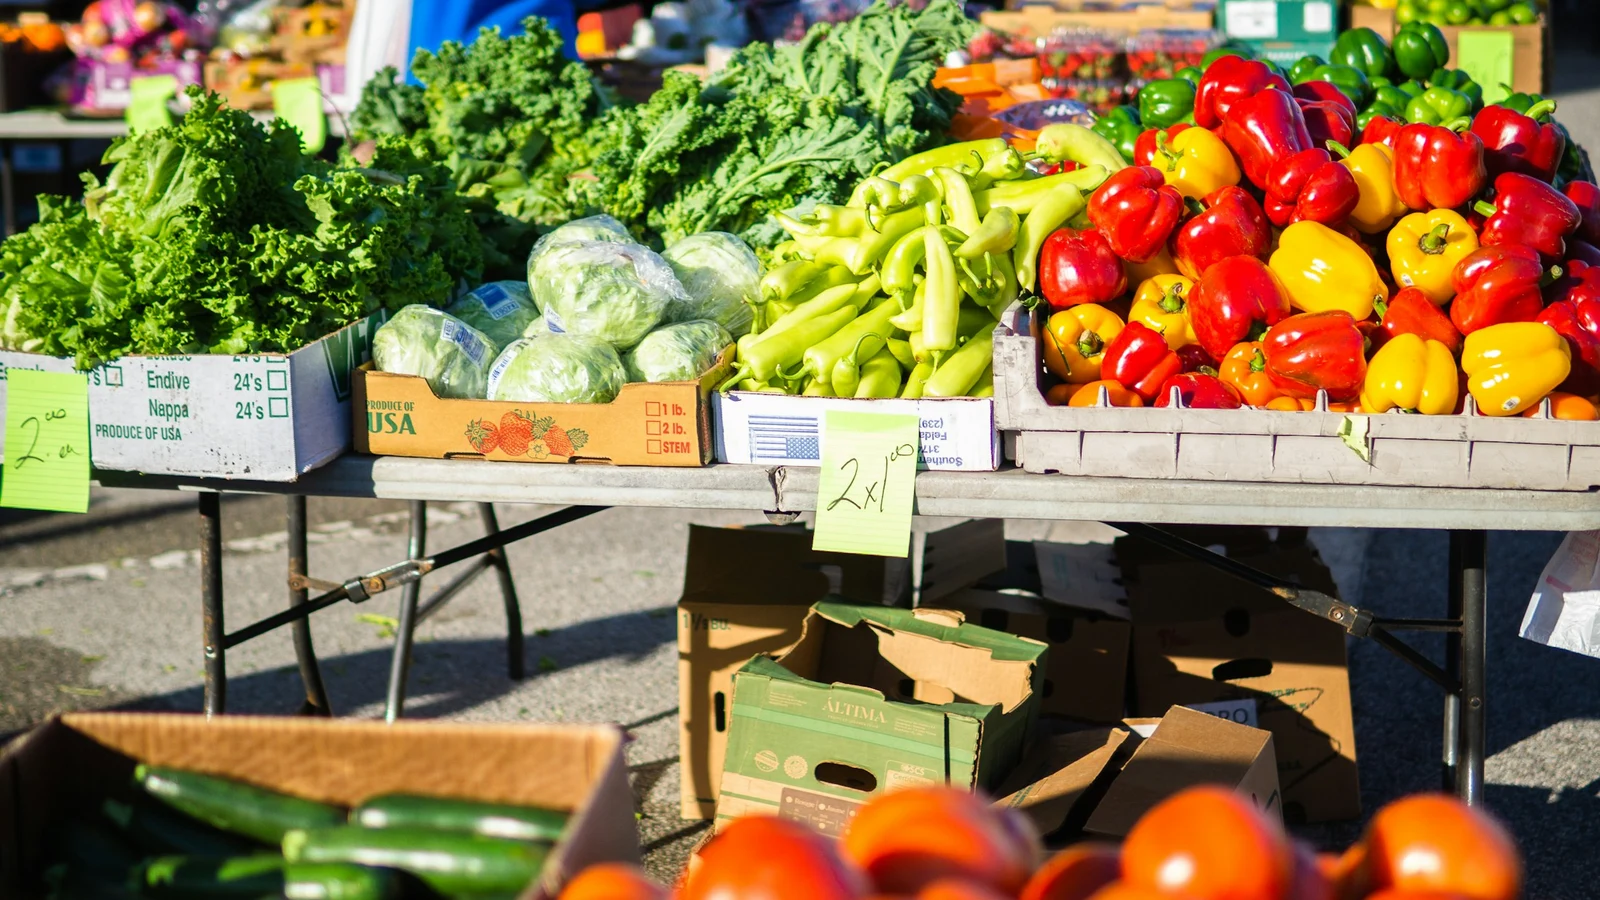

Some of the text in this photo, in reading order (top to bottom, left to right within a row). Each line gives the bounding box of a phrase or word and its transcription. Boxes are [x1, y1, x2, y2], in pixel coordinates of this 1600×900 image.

[147, 371, 262, 391] Endive 24's
[149, 399, 264, 421] Nappa 24's
[404, 401, 415, 411] OF
[662, 403, 686, 416] 1 lb.
[368, 412, 417, 435] USA
[662, 422, 687, 435] 2 lb.
[95, 424, 182, 441] PRODUCE OF USA
[663, 441, 691, 454] STEM
